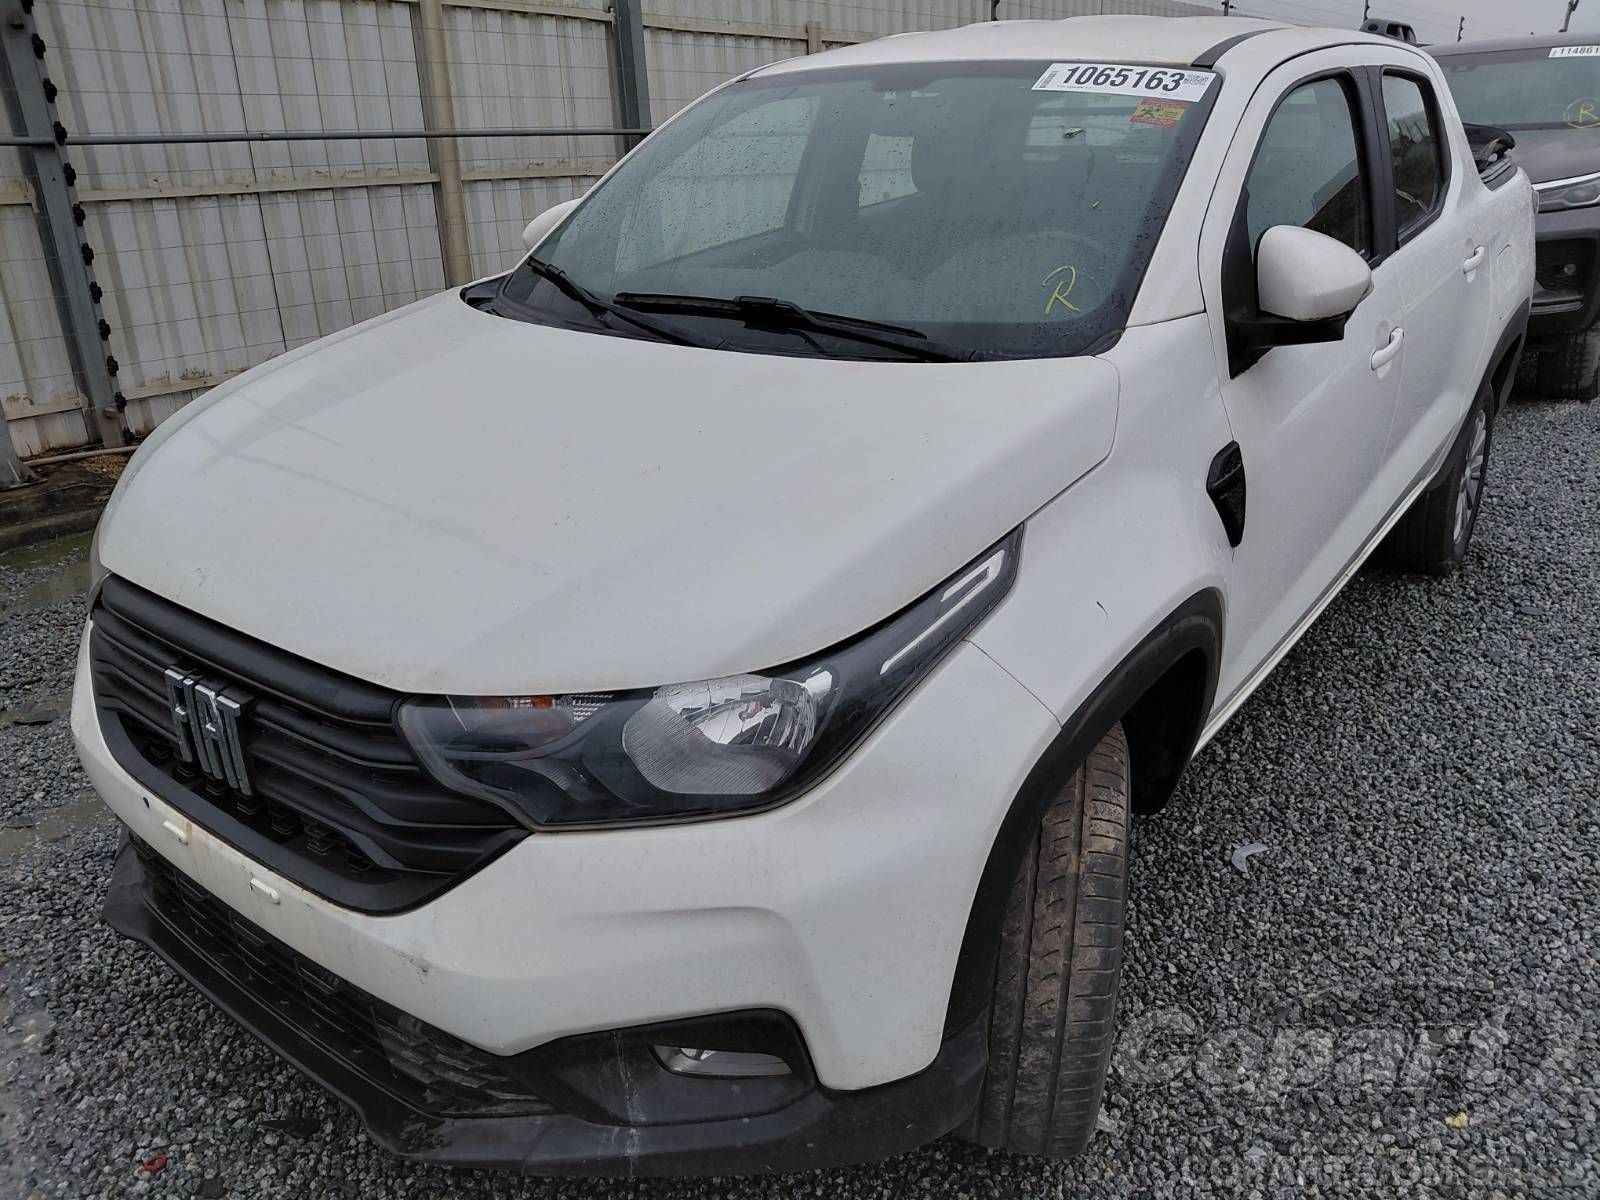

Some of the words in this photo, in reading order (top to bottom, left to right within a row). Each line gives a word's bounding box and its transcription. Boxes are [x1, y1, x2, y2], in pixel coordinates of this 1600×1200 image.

[1063, 66, 1185, 92] 1065163
[1042, 265, 1081, 315] R
[164, 668, 252, 796] FIAT
